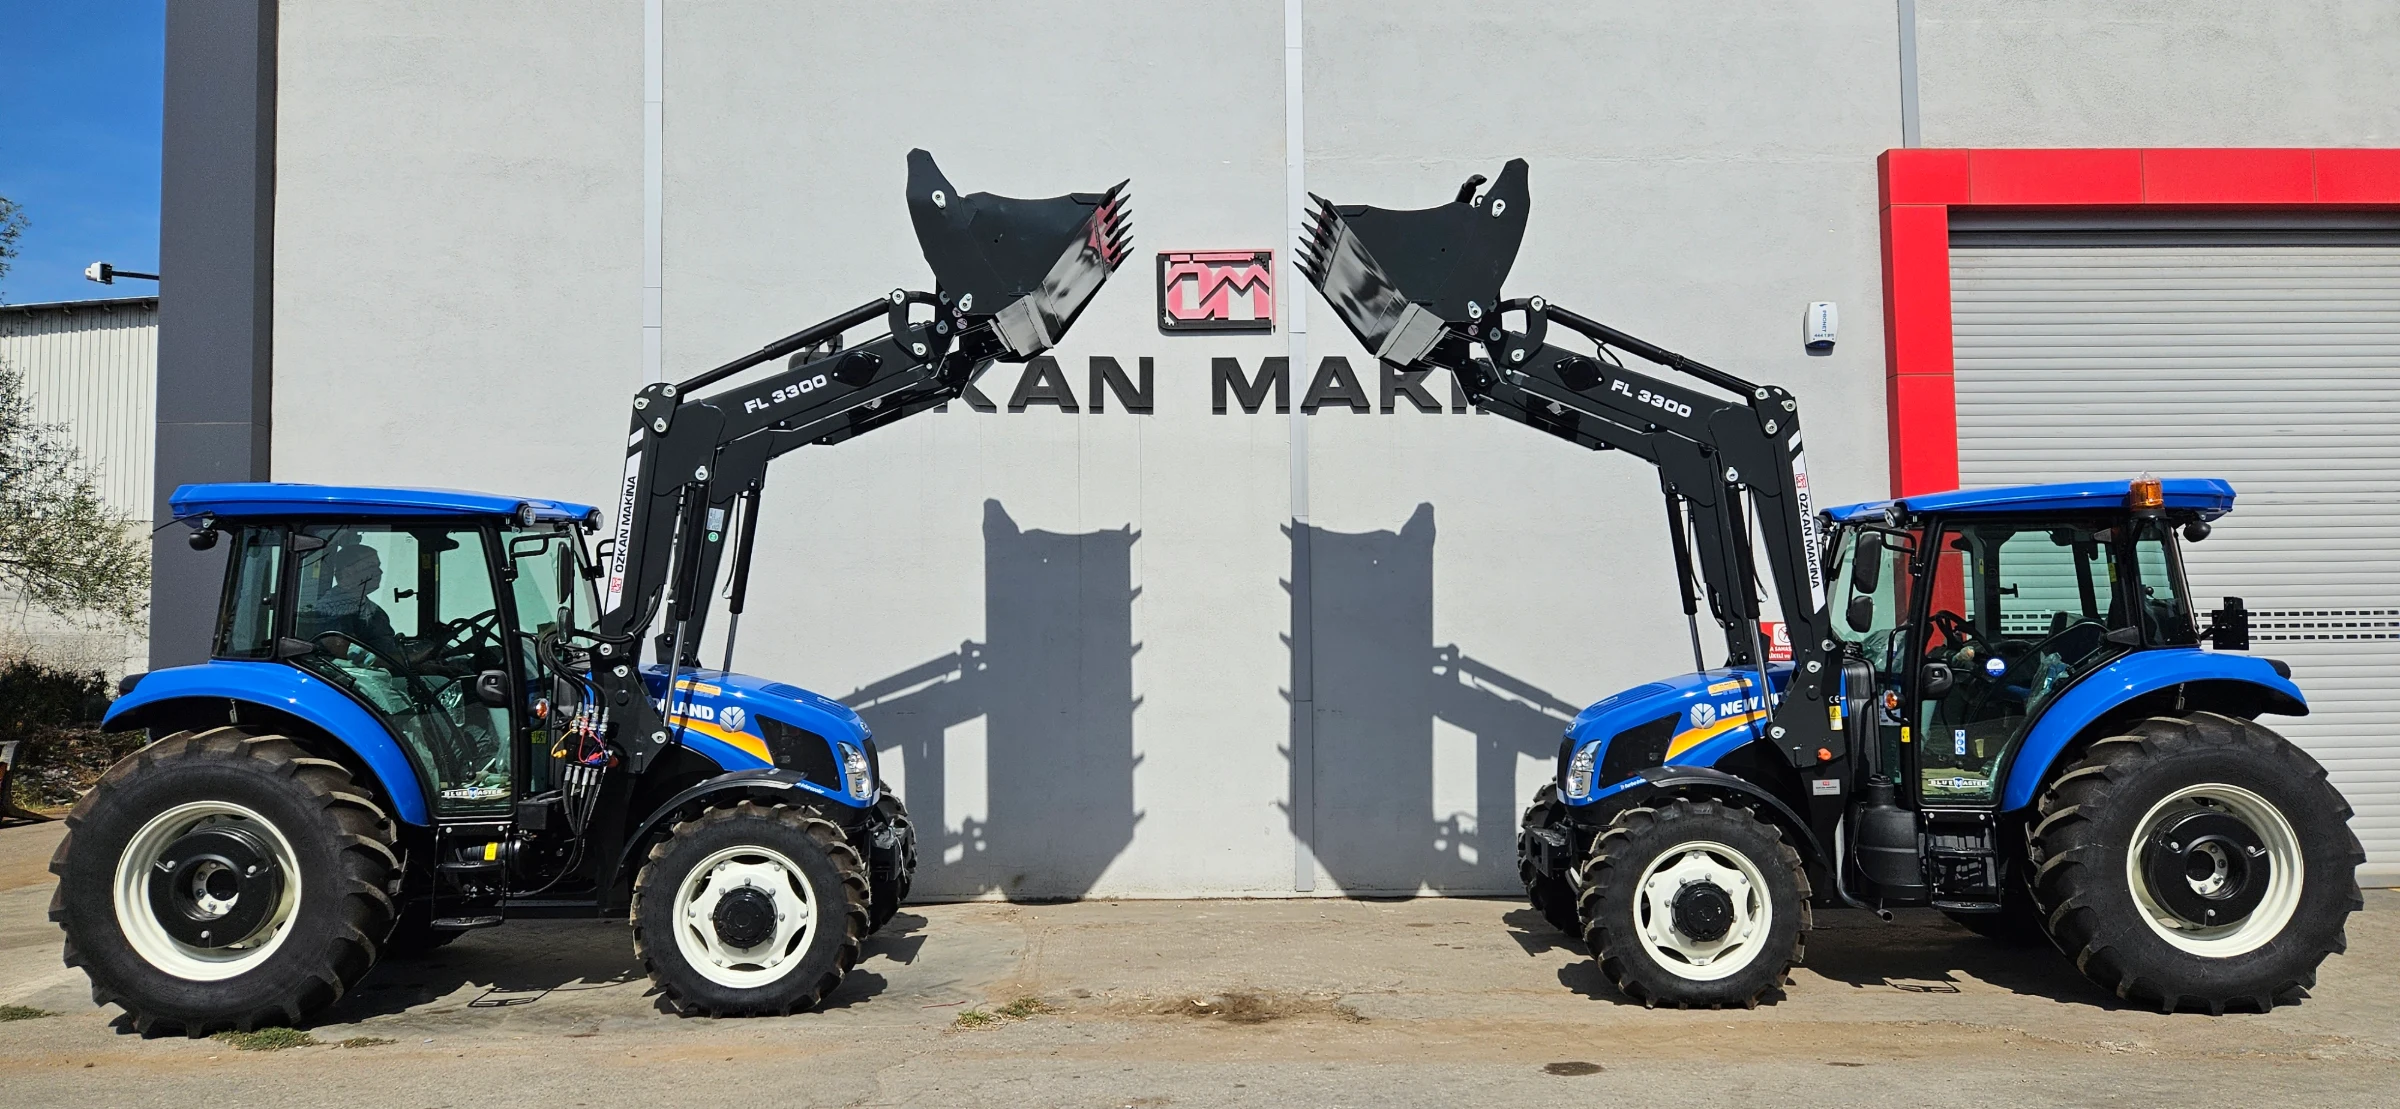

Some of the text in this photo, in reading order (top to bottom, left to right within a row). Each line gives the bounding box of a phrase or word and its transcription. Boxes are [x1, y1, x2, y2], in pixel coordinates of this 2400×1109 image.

[744, 374, 827, 414] FL 3300
[1611, 379, 1692, 418] FL 3300
[1799, 493, 1812, 537] ÖZKAN
[614, 528, 629, 573] ÖZKAN
[1720, 696, 1759, 717] NEW
